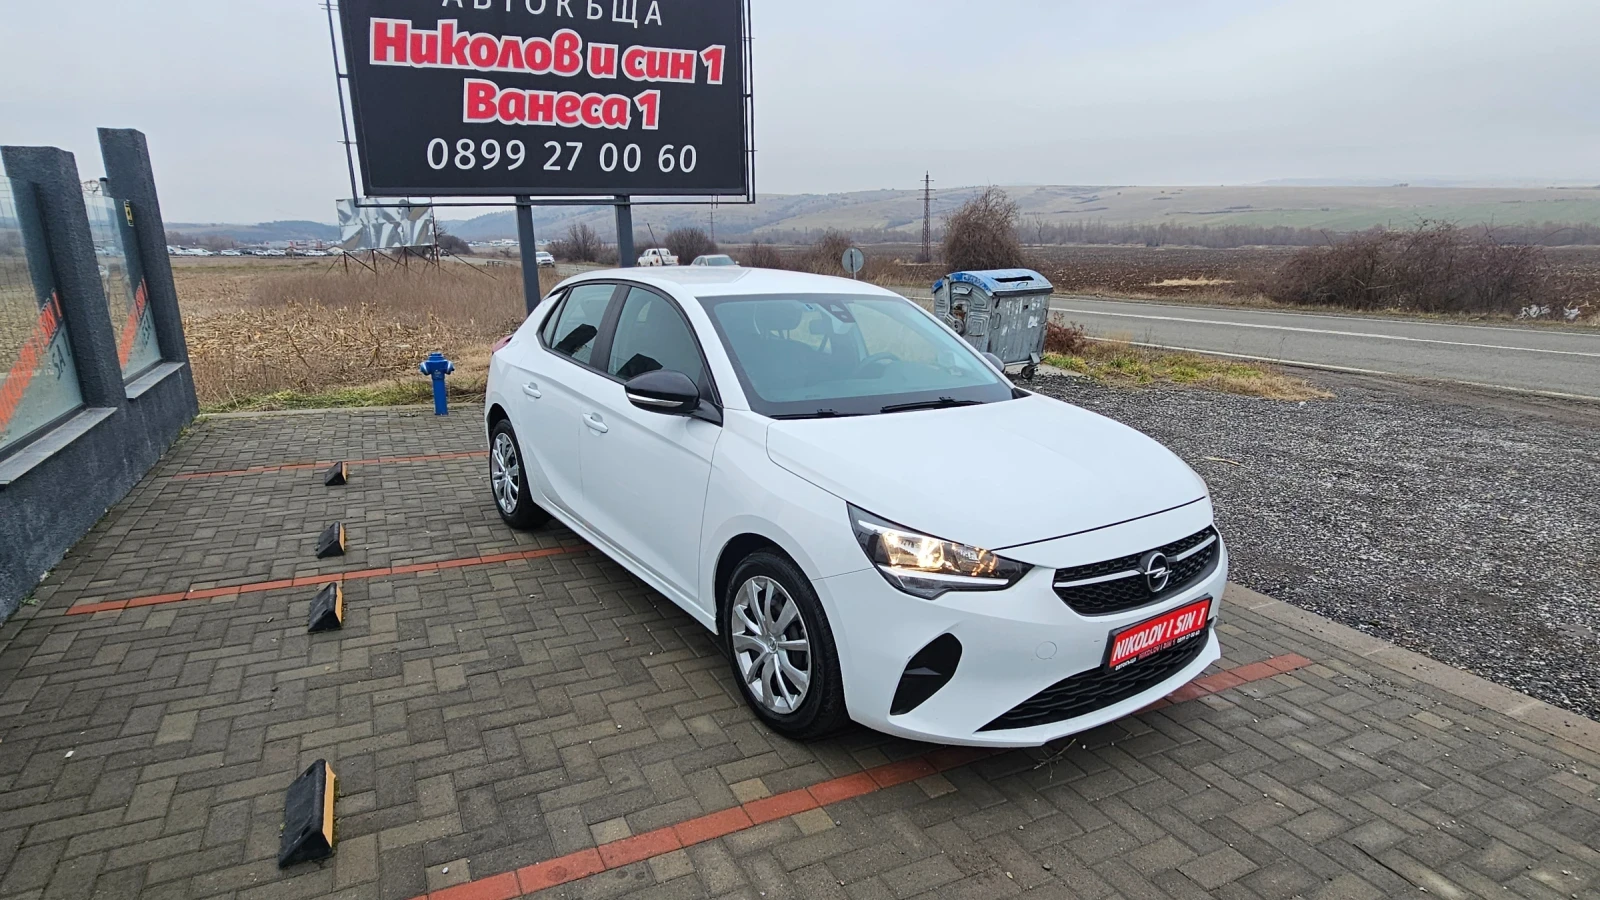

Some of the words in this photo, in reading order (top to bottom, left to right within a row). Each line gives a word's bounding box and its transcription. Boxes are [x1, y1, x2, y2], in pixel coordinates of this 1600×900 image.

[370, 17, 583, 76] Николов
[587, 42, 619, 79] и
[622, 45, 696, 83] син
[700, 44, 725, 85] 1
[463, 78, 632, 130] Ванеса
[633, 90, 660, 130] 1
[427, 137, 526, 171] 0899
[543, 140, 583, 171] 27
[600, 142, 641, 172] 00
[657, 144, 697, 173] 60
[1112, 621, 1168, 662] NIKOLOV
[1165, 619, 1175, 638] I
[1173, 610, 1197, 635] SIN
[1197, 607, 1206, 626] 1
